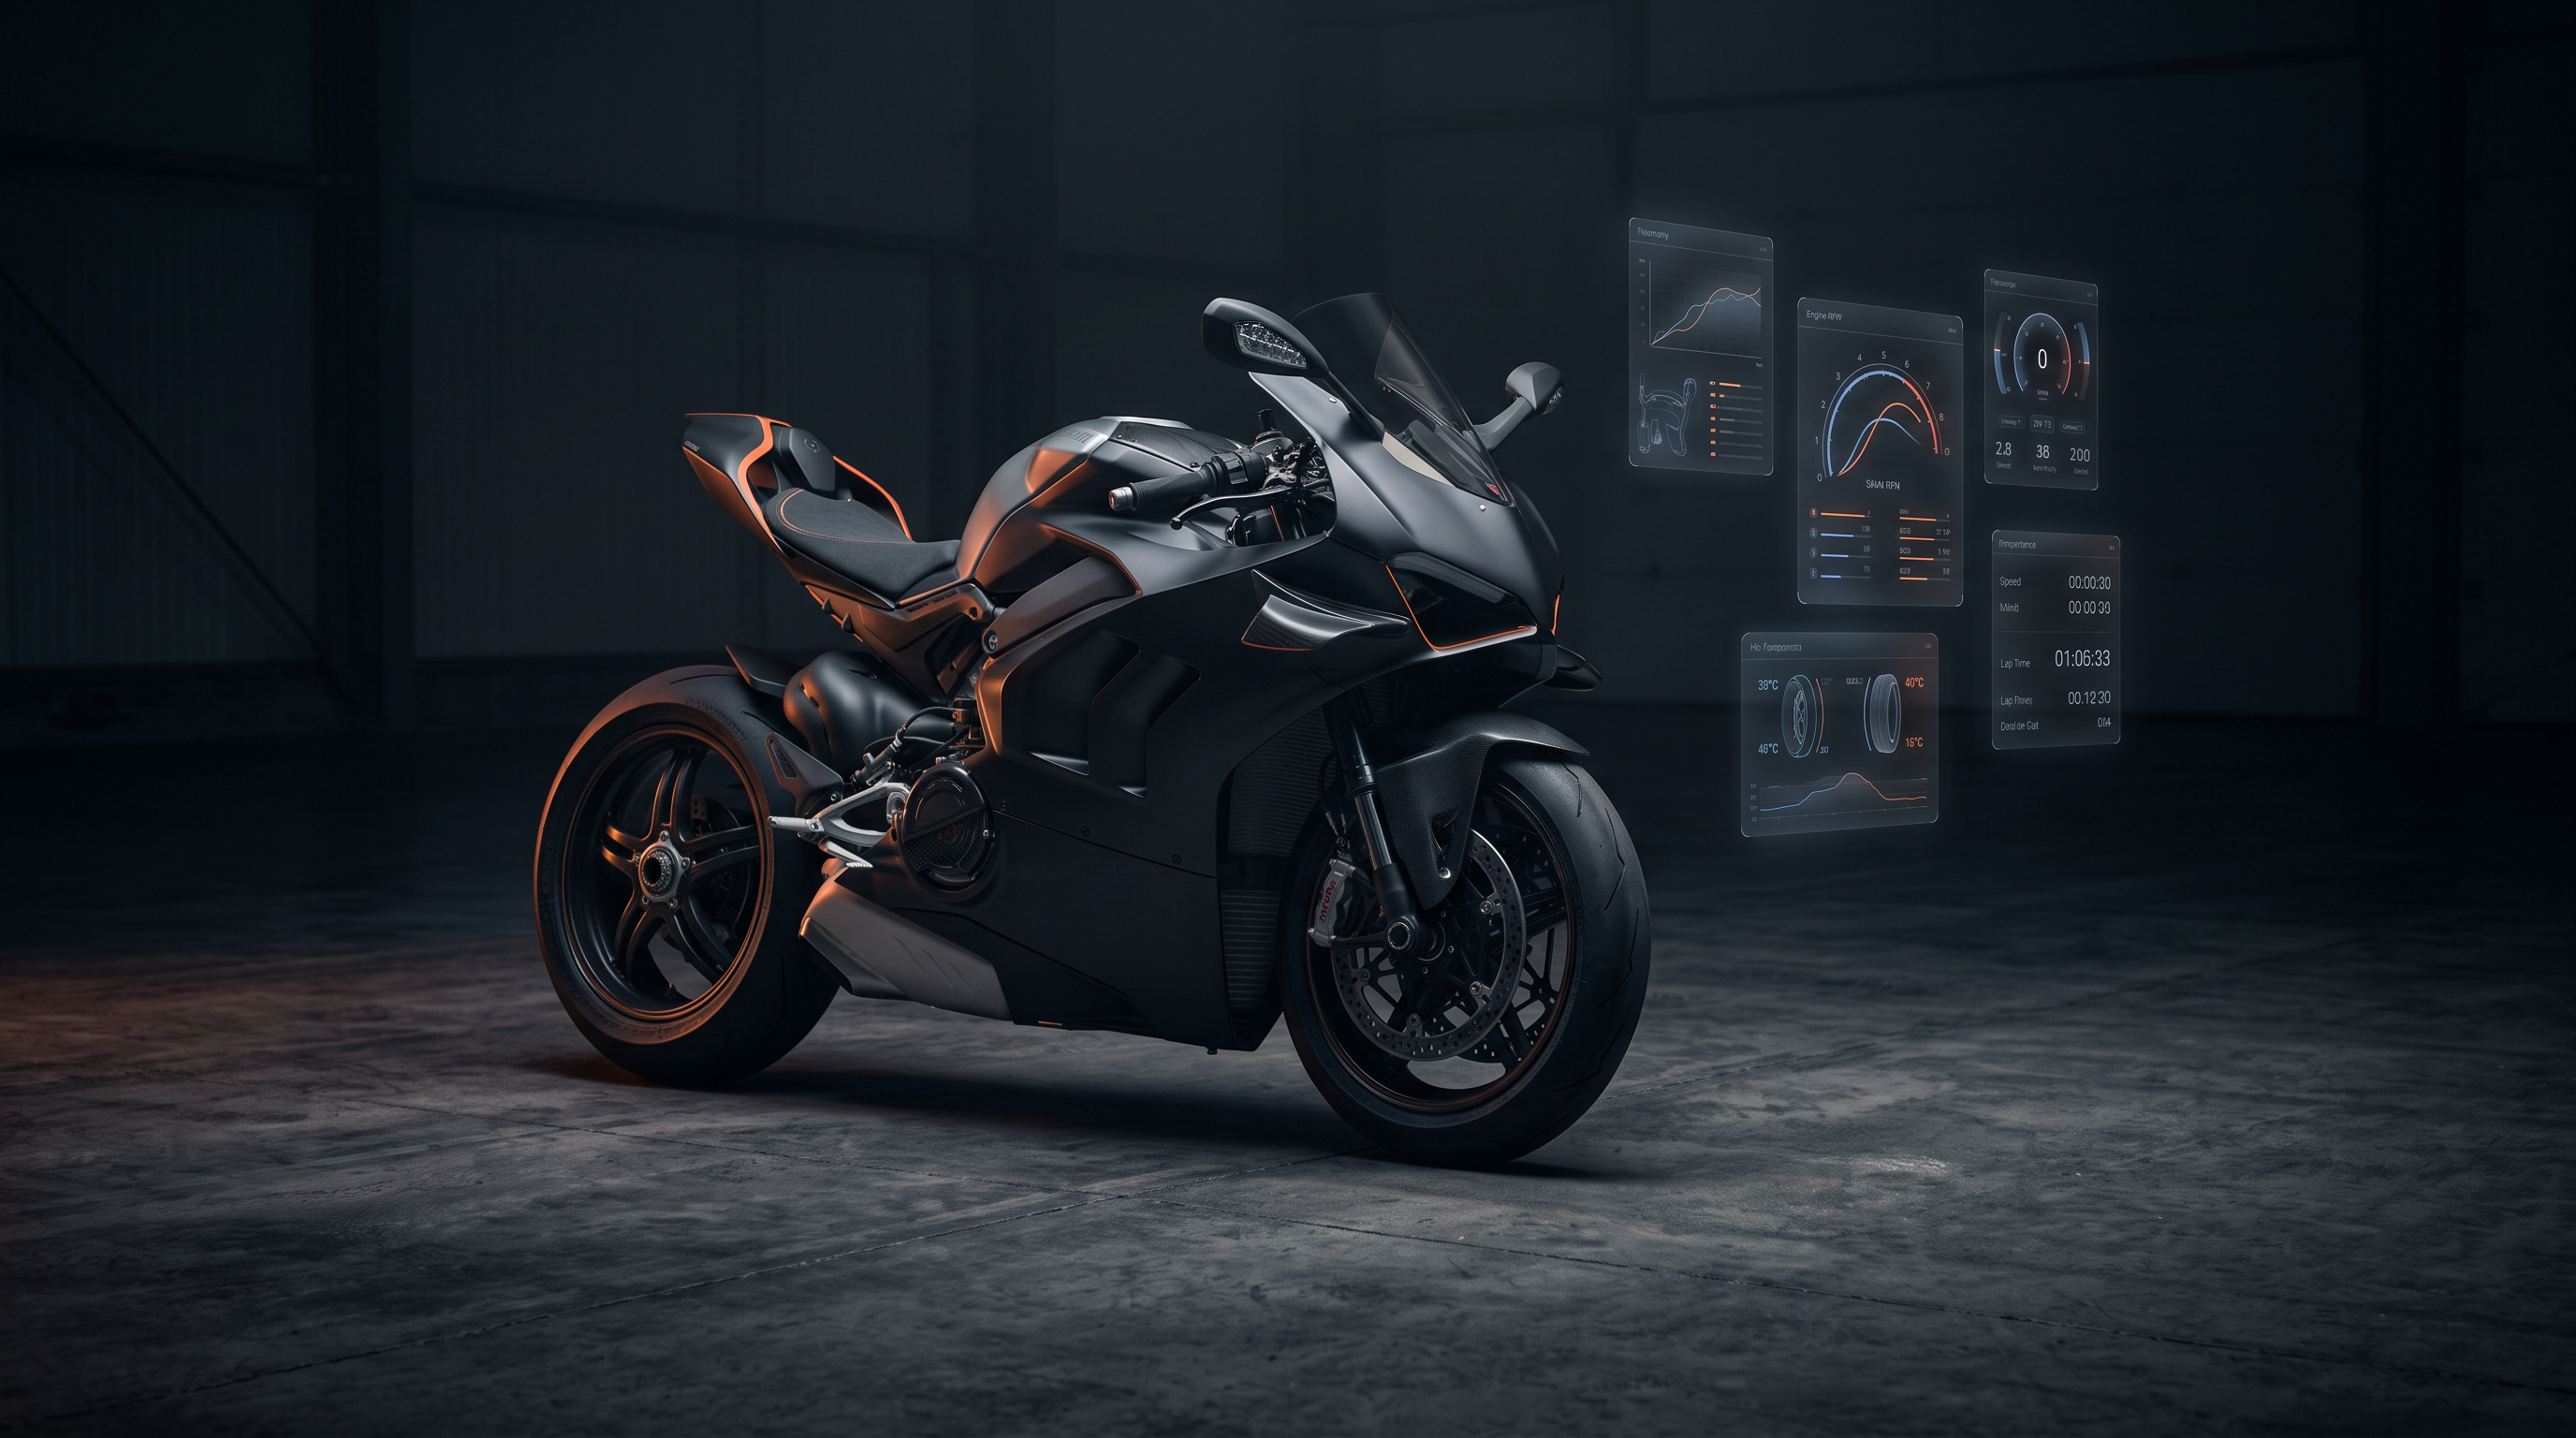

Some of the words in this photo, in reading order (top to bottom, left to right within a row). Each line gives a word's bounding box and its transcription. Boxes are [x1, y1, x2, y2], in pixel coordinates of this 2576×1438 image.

[1807, 310, 1827, 321] Engine
[1881, 351, 1886, 360] 5
[2038, 348, 2048, 370] 0
[1904, 360, 1910, 368] 6
[1836, 372, 1841, 381] 3
[1925, 382, 1931, 390] 7
[1821, 401, 1826, 409] 2
[1814, 436, 1819, 445] 1
[2036, 444, 2050, 459] 38
[2070, 448, 2090, 462] 200
[1817, 474, 1822, 482] 0
[1999, 576, 2022, 588] Speed
[2000, 658, 2013, 670] Lap
[2013, 658, 2031, 668] Time
[2055, 649, 2111, 668] 01:06:33
[1757, 679, 1778, 691] 38°C
[1904, 677, 1925, 688] 40°C
[2000, 696, 2013, 707] Lap
